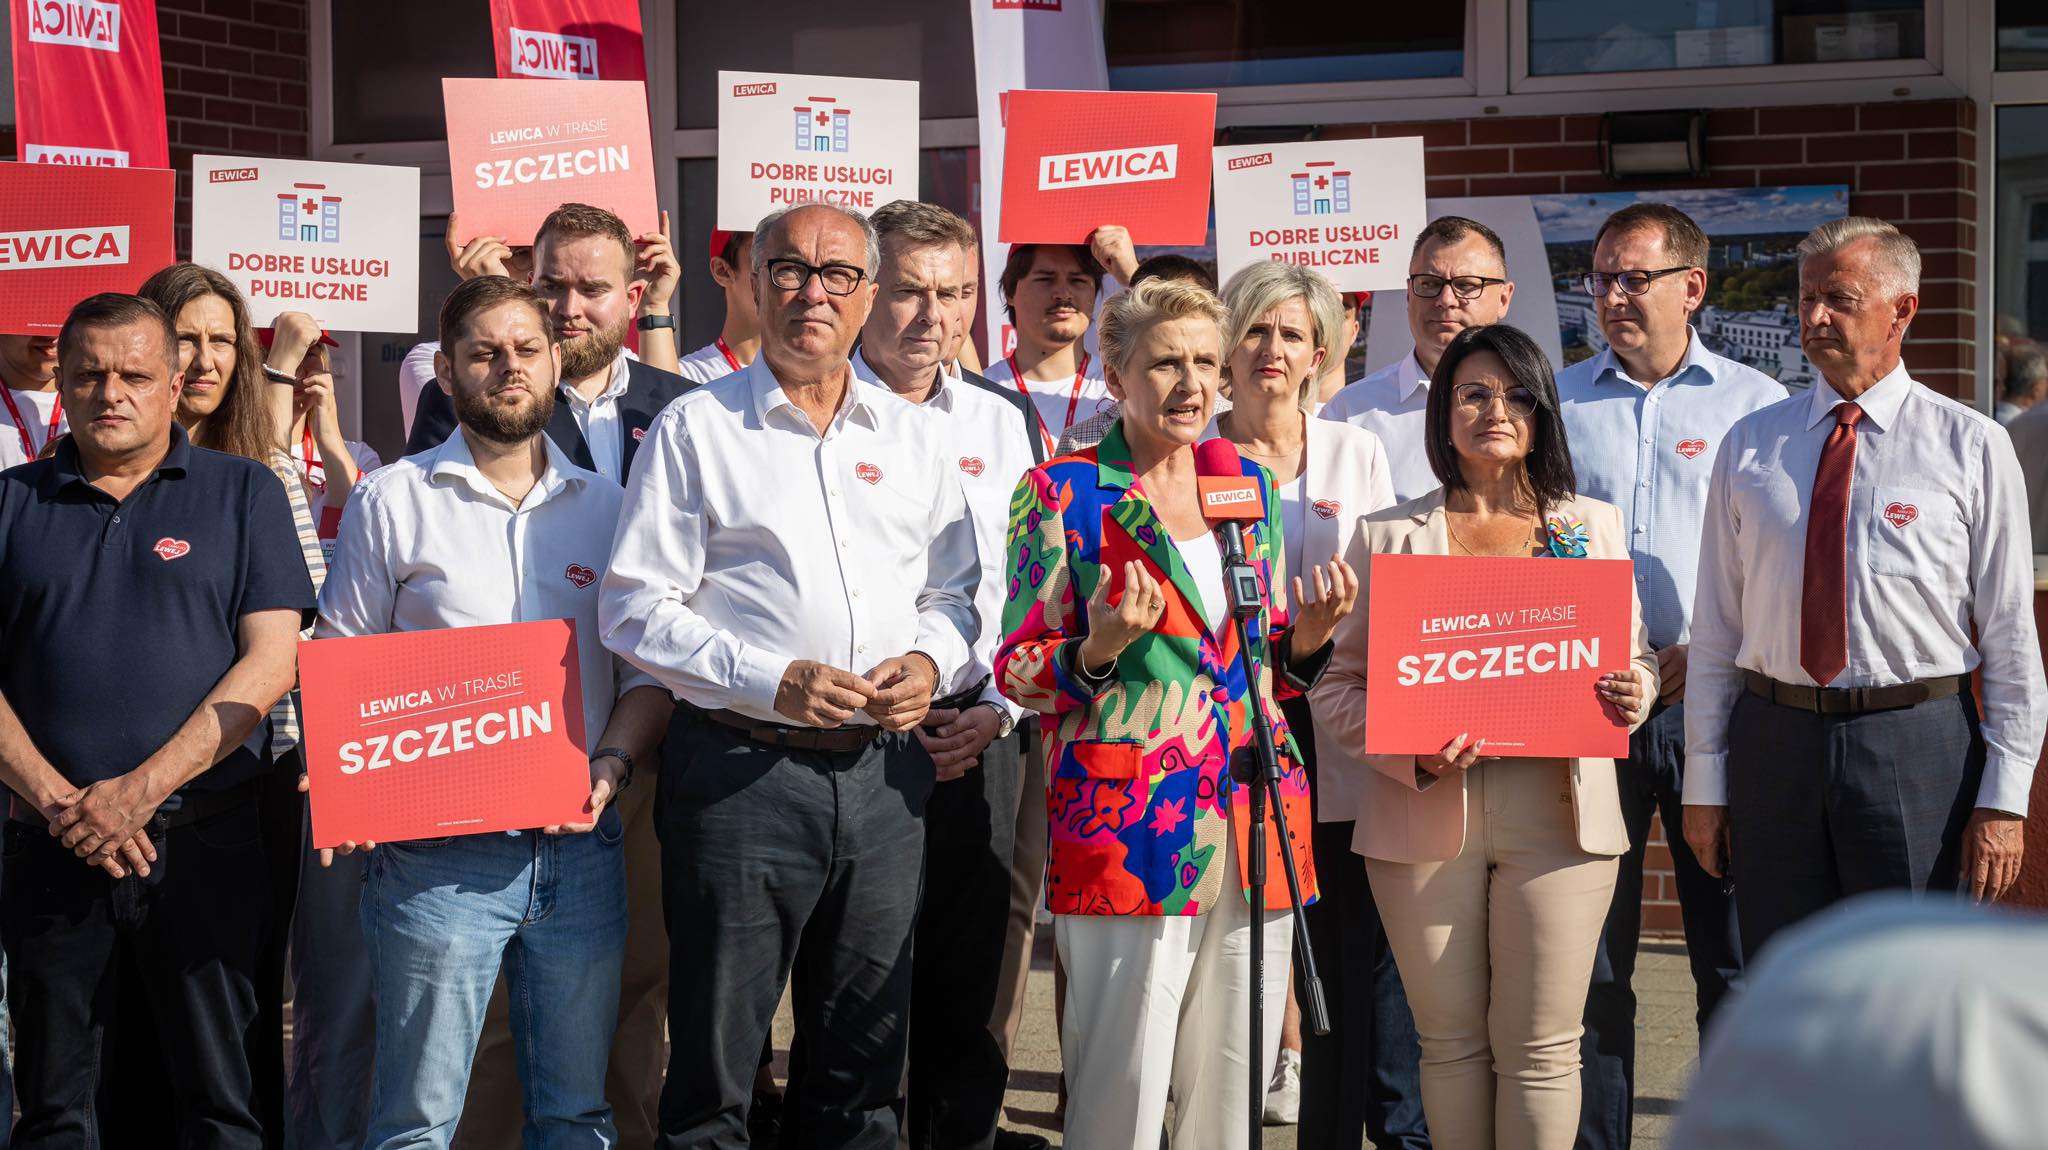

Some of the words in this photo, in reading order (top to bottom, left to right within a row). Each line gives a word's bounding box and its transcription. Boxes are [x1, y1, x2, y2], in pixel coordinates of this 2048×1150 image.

[736, 84, 775, 96] LEWICA
[490, 127, 543, 145] LEWICA
[546, 125, 560, 137] W
[564, 118, 608, 135] TRASIE
[475, 144, 630, 189] SZCZECIN
[751, 162, 817, 182] DOBRE
[824, 166, 892, 185] USŁUGI
[1048, 151, 1168, 184] LEWICA
[1230, 154, 1270, 169] LEWICA
[212, 169, 256, 182] LEWICA
[770, 187, 874, 208] PUBLICZNE
[1250, 227, 1319, 247] DOBRE
[1326, 224, 1398, 243] USŁUGI
[0, 232, 120, 264] EWICA
[229, 253, 304, 274] DOBRE
[311, 257, 389, 277] USŁUGI
[250, 279, 368, 301] PUBLICZNE
[1210, 491, 1253, 503] LEWICA
[1422, 613, 1491, 634] LEWICA
[1496, 611, 1514, 626] W
[1520, 604, 1577, 625] TRASIE
[1397, 637, 1599, 687] SZCZECIN
[360, 689, 433, 718] LEWICA
[437, 684, 456, 702] W
[462, 670, 522, 697] TRASIE
[338, 701, 552, 775] SZCZECIN
